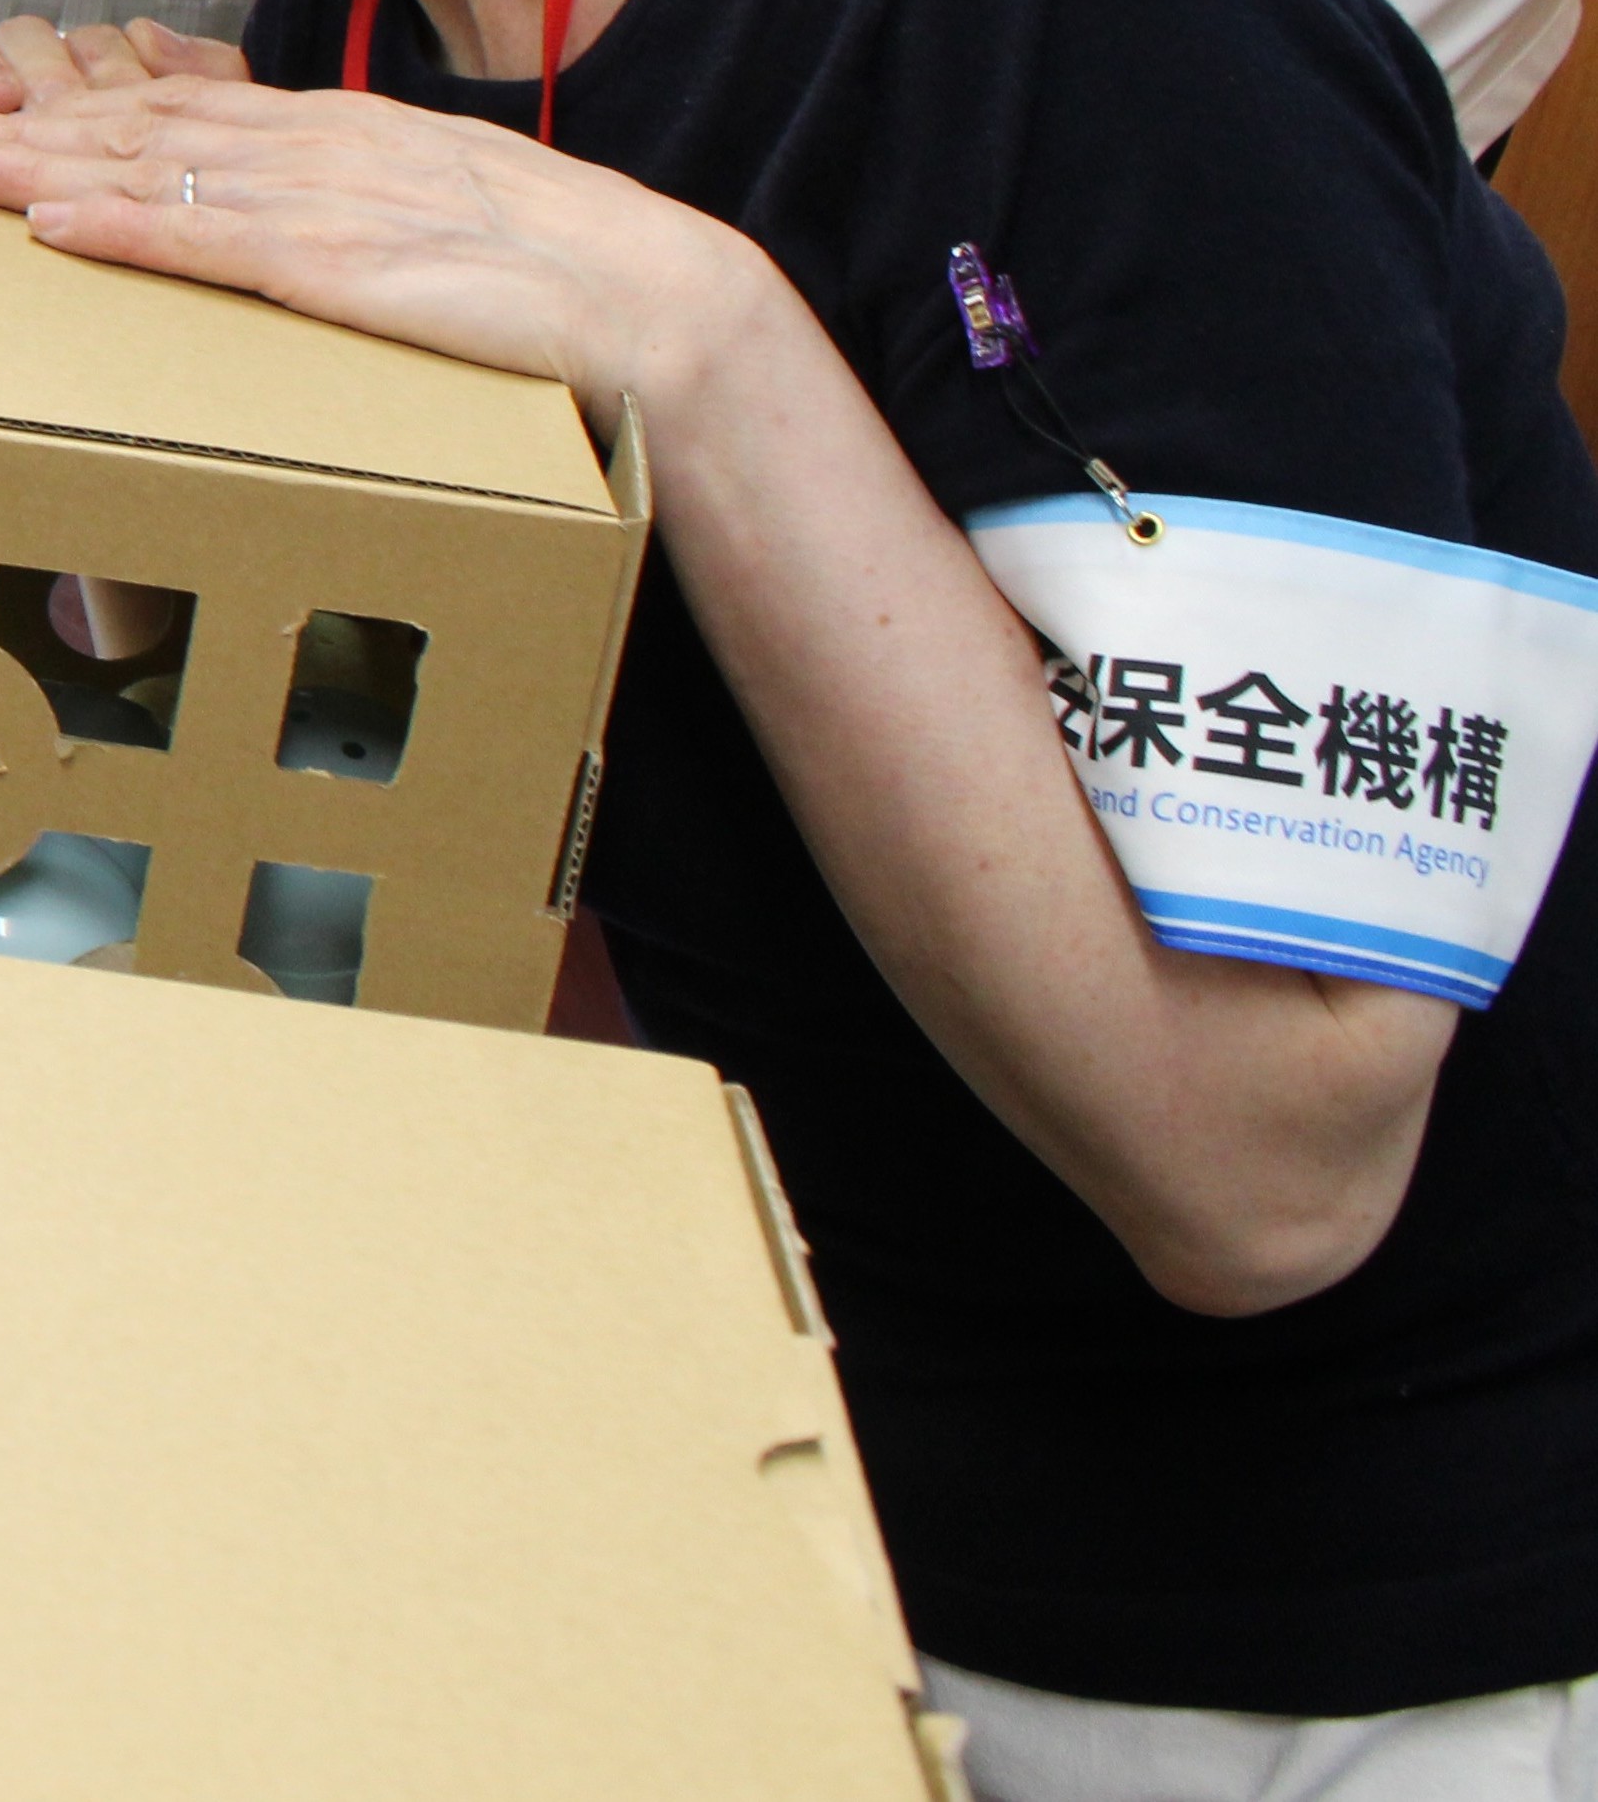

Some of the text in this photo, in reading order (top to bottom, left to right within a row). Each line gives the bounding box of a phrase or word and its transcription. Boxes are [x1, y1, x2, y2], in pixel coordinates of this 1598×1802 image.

[1091, 786, 1490, 888] and Conservation Agency
